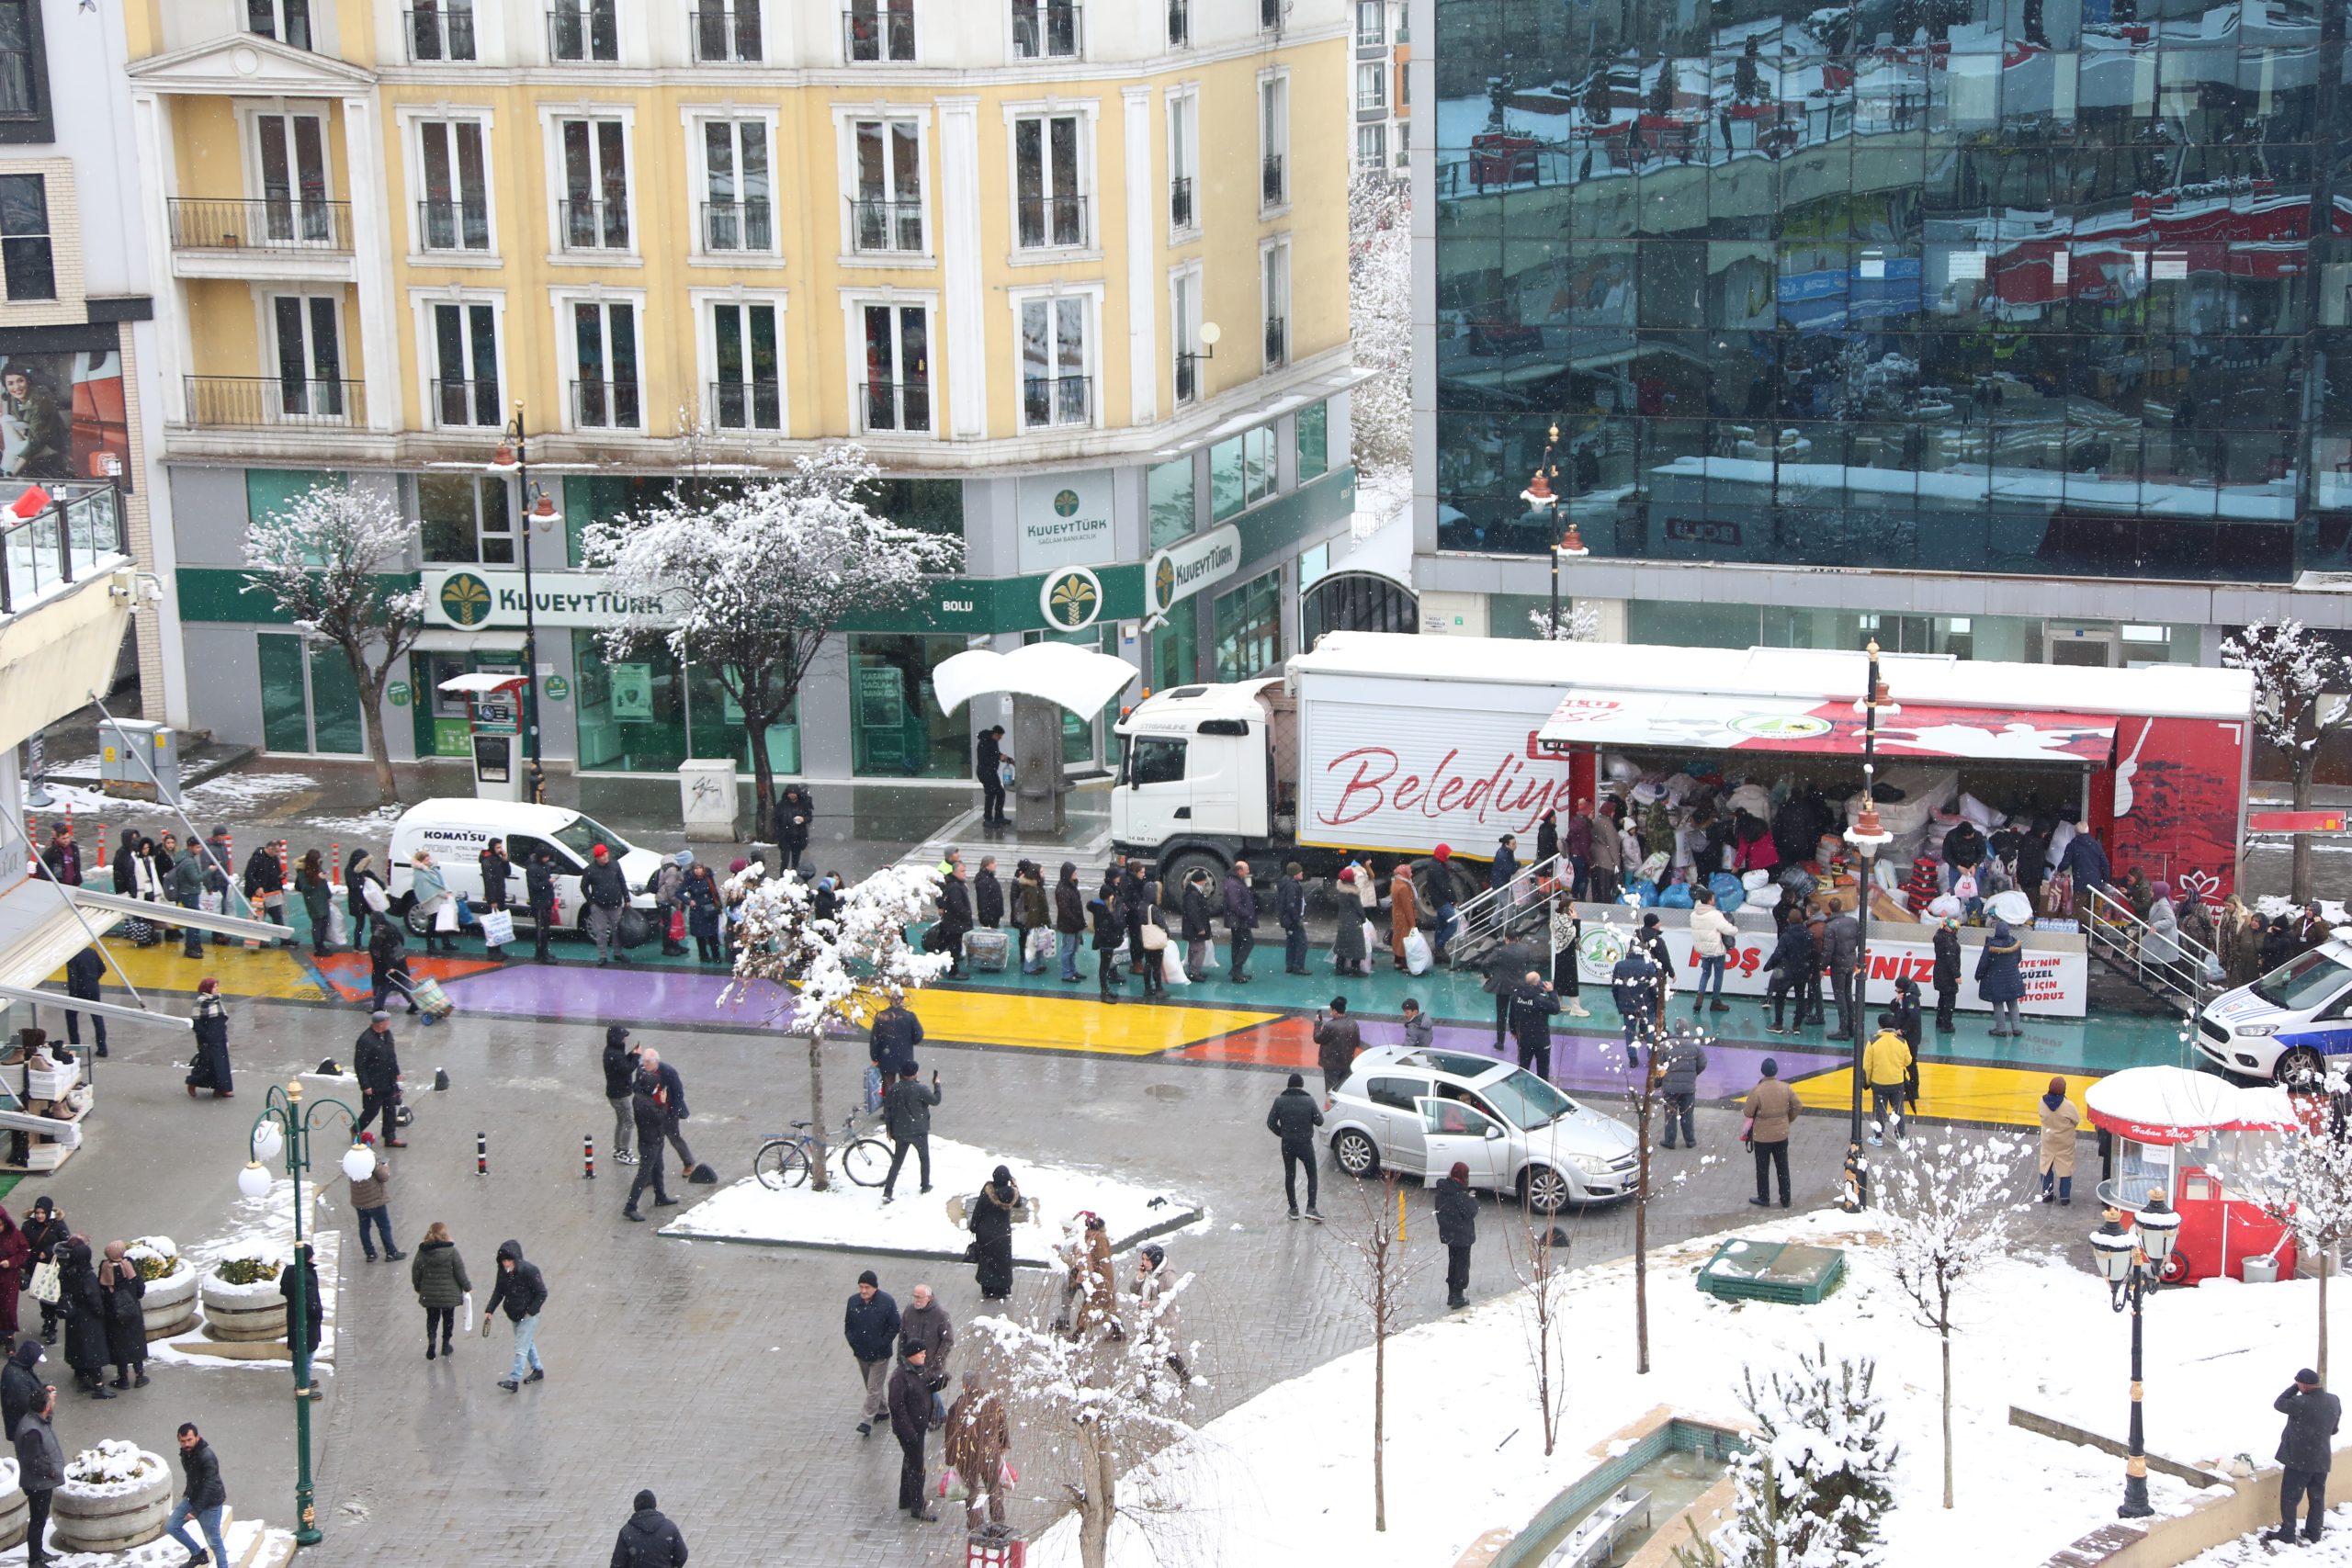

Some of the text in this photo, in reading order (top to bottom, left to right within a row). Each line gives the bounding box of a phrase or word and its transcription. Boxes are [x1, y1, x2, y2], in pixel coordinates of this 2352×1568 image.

[943, 600, 973, 612] BOLU
[1317, 747, 1570, 834] Belediye
[424, 831, 486, 841] KOMATSU
[2021, 969, 2053, 979] GÜZEL
[2035, 980, 2057, 991] İÇİN
[2132, 1125, 2161, 1137] Hakan
